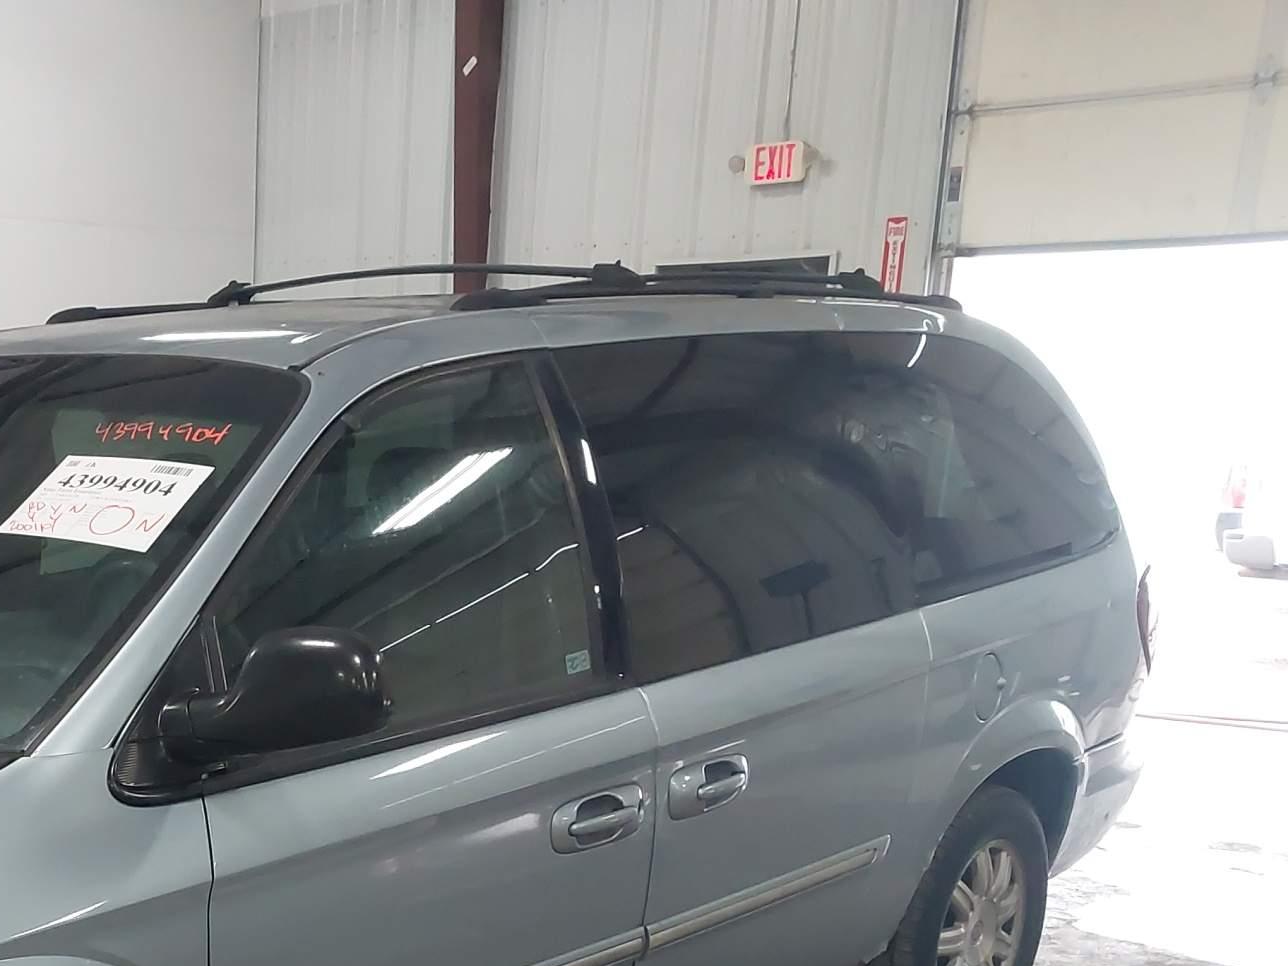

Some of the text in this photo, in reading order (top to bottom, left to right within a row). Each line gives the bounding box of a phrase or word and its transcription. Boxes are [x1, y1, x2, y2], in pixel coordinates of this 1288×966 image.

[754, 144, 796, 181] EXIT
[889, 226, 904, 236] FIRE
[96, 421, 232, 445] 43994904
[58, 473, 178, 497] 43994904
